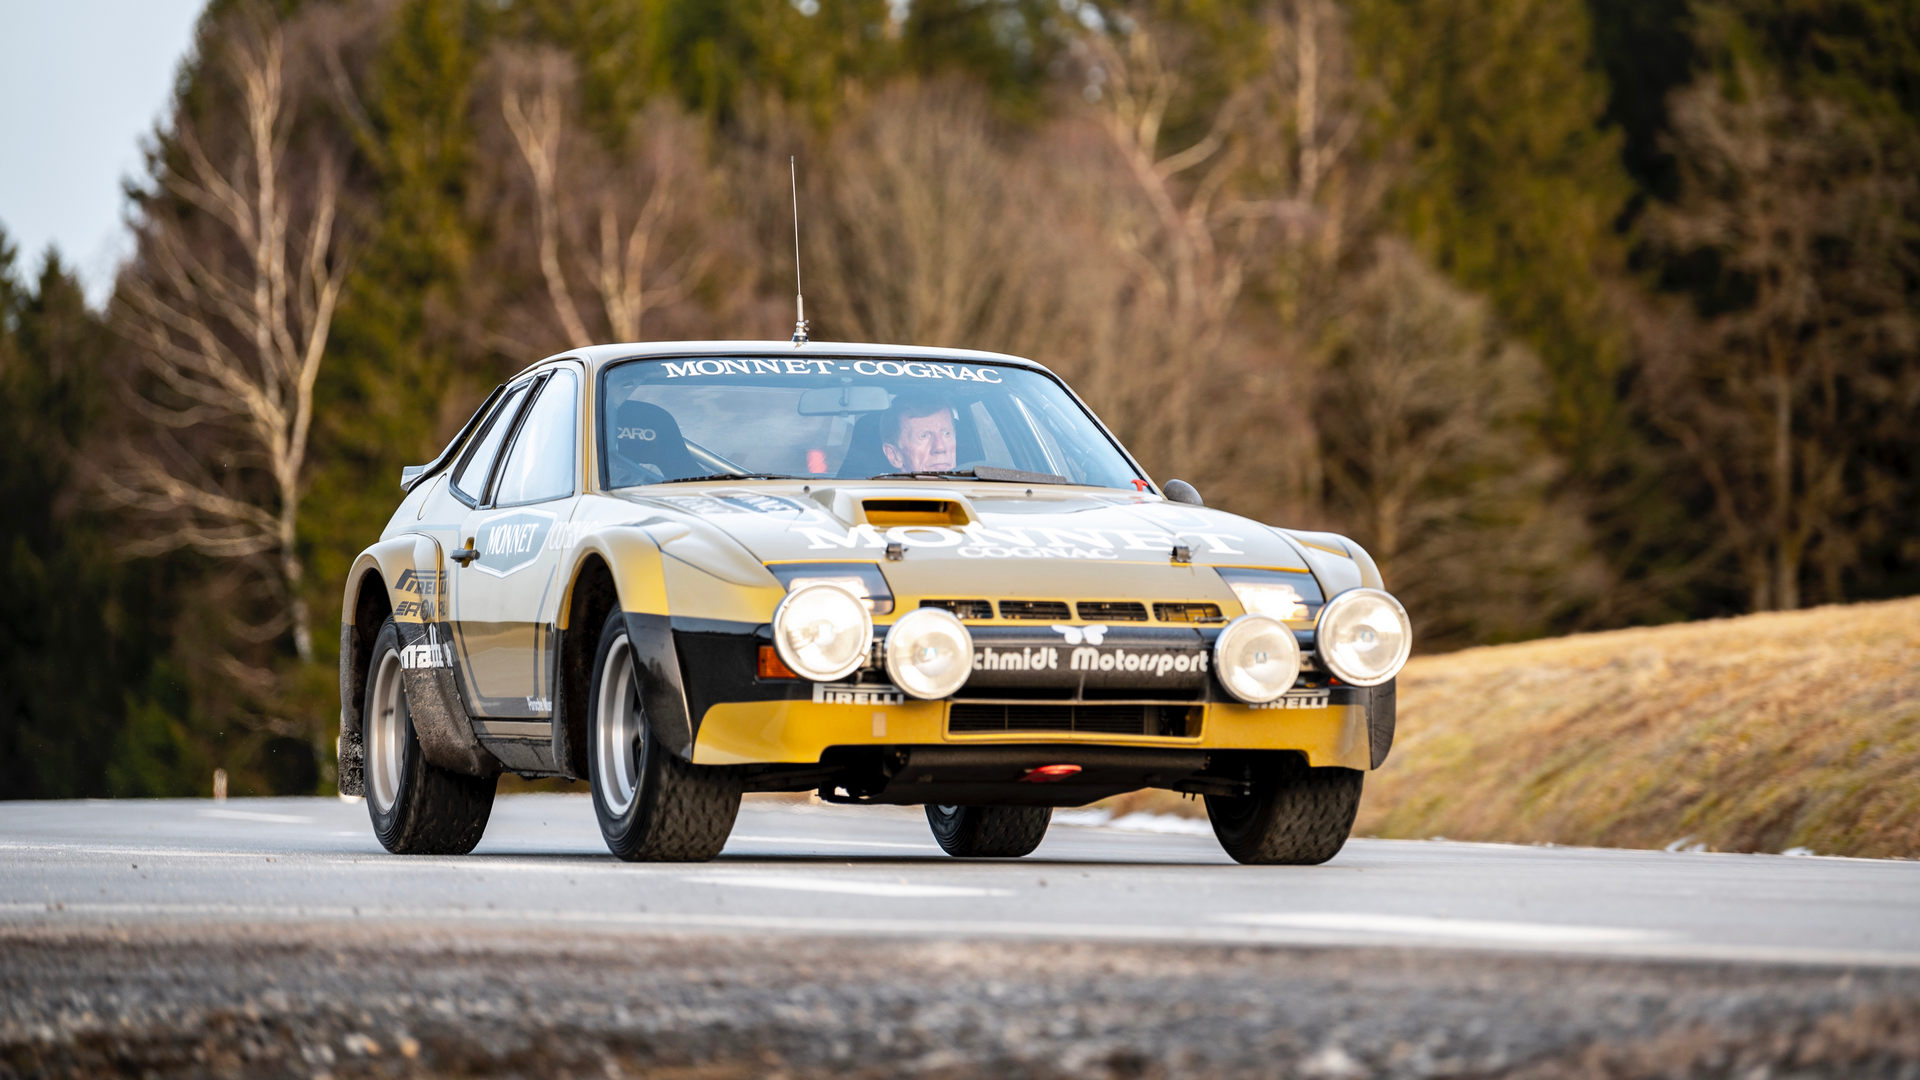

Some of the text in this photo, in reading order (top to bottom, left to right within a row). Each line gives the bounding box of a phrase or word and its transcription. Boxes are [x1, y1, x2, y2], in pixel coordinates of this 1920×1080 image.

[617, 427, 657, 441] CARO
[485, 522, 540, 558] MONNET
[788, 524, 1245, 555] MONNET
[957, 546, 1118, 559] COGNAC
[972, 647, 1209, 677] chmidt Motorsport
[812, 682, 904, 706] PIRELLI
